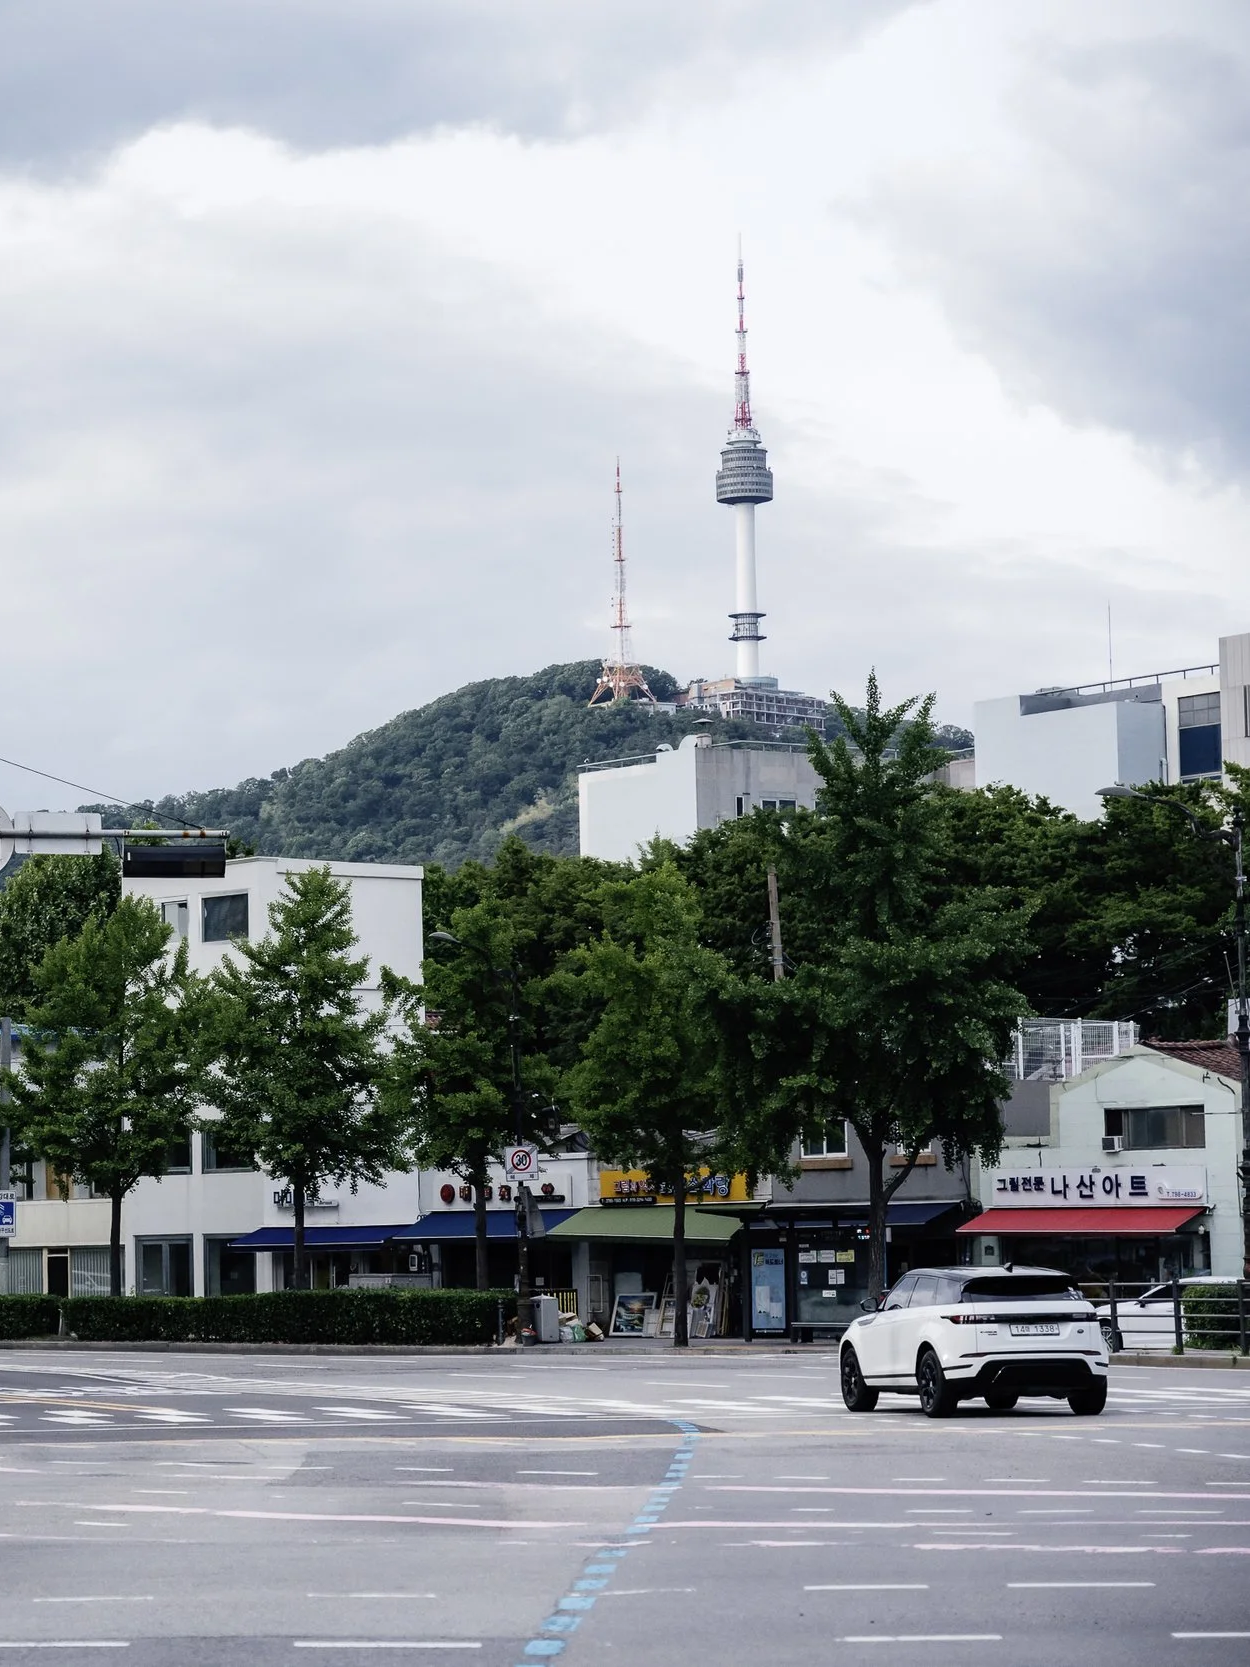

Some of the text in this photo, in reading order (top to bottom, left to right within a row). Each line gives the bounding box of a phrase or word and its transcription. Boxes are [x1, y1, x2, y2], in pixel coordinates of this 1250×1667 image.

[515, 1154, 527, 1167] 30
[996, 1174, 1149, 1199] 그림전문 나산아트
[1034, 1325, 1055, 1333] 1338
